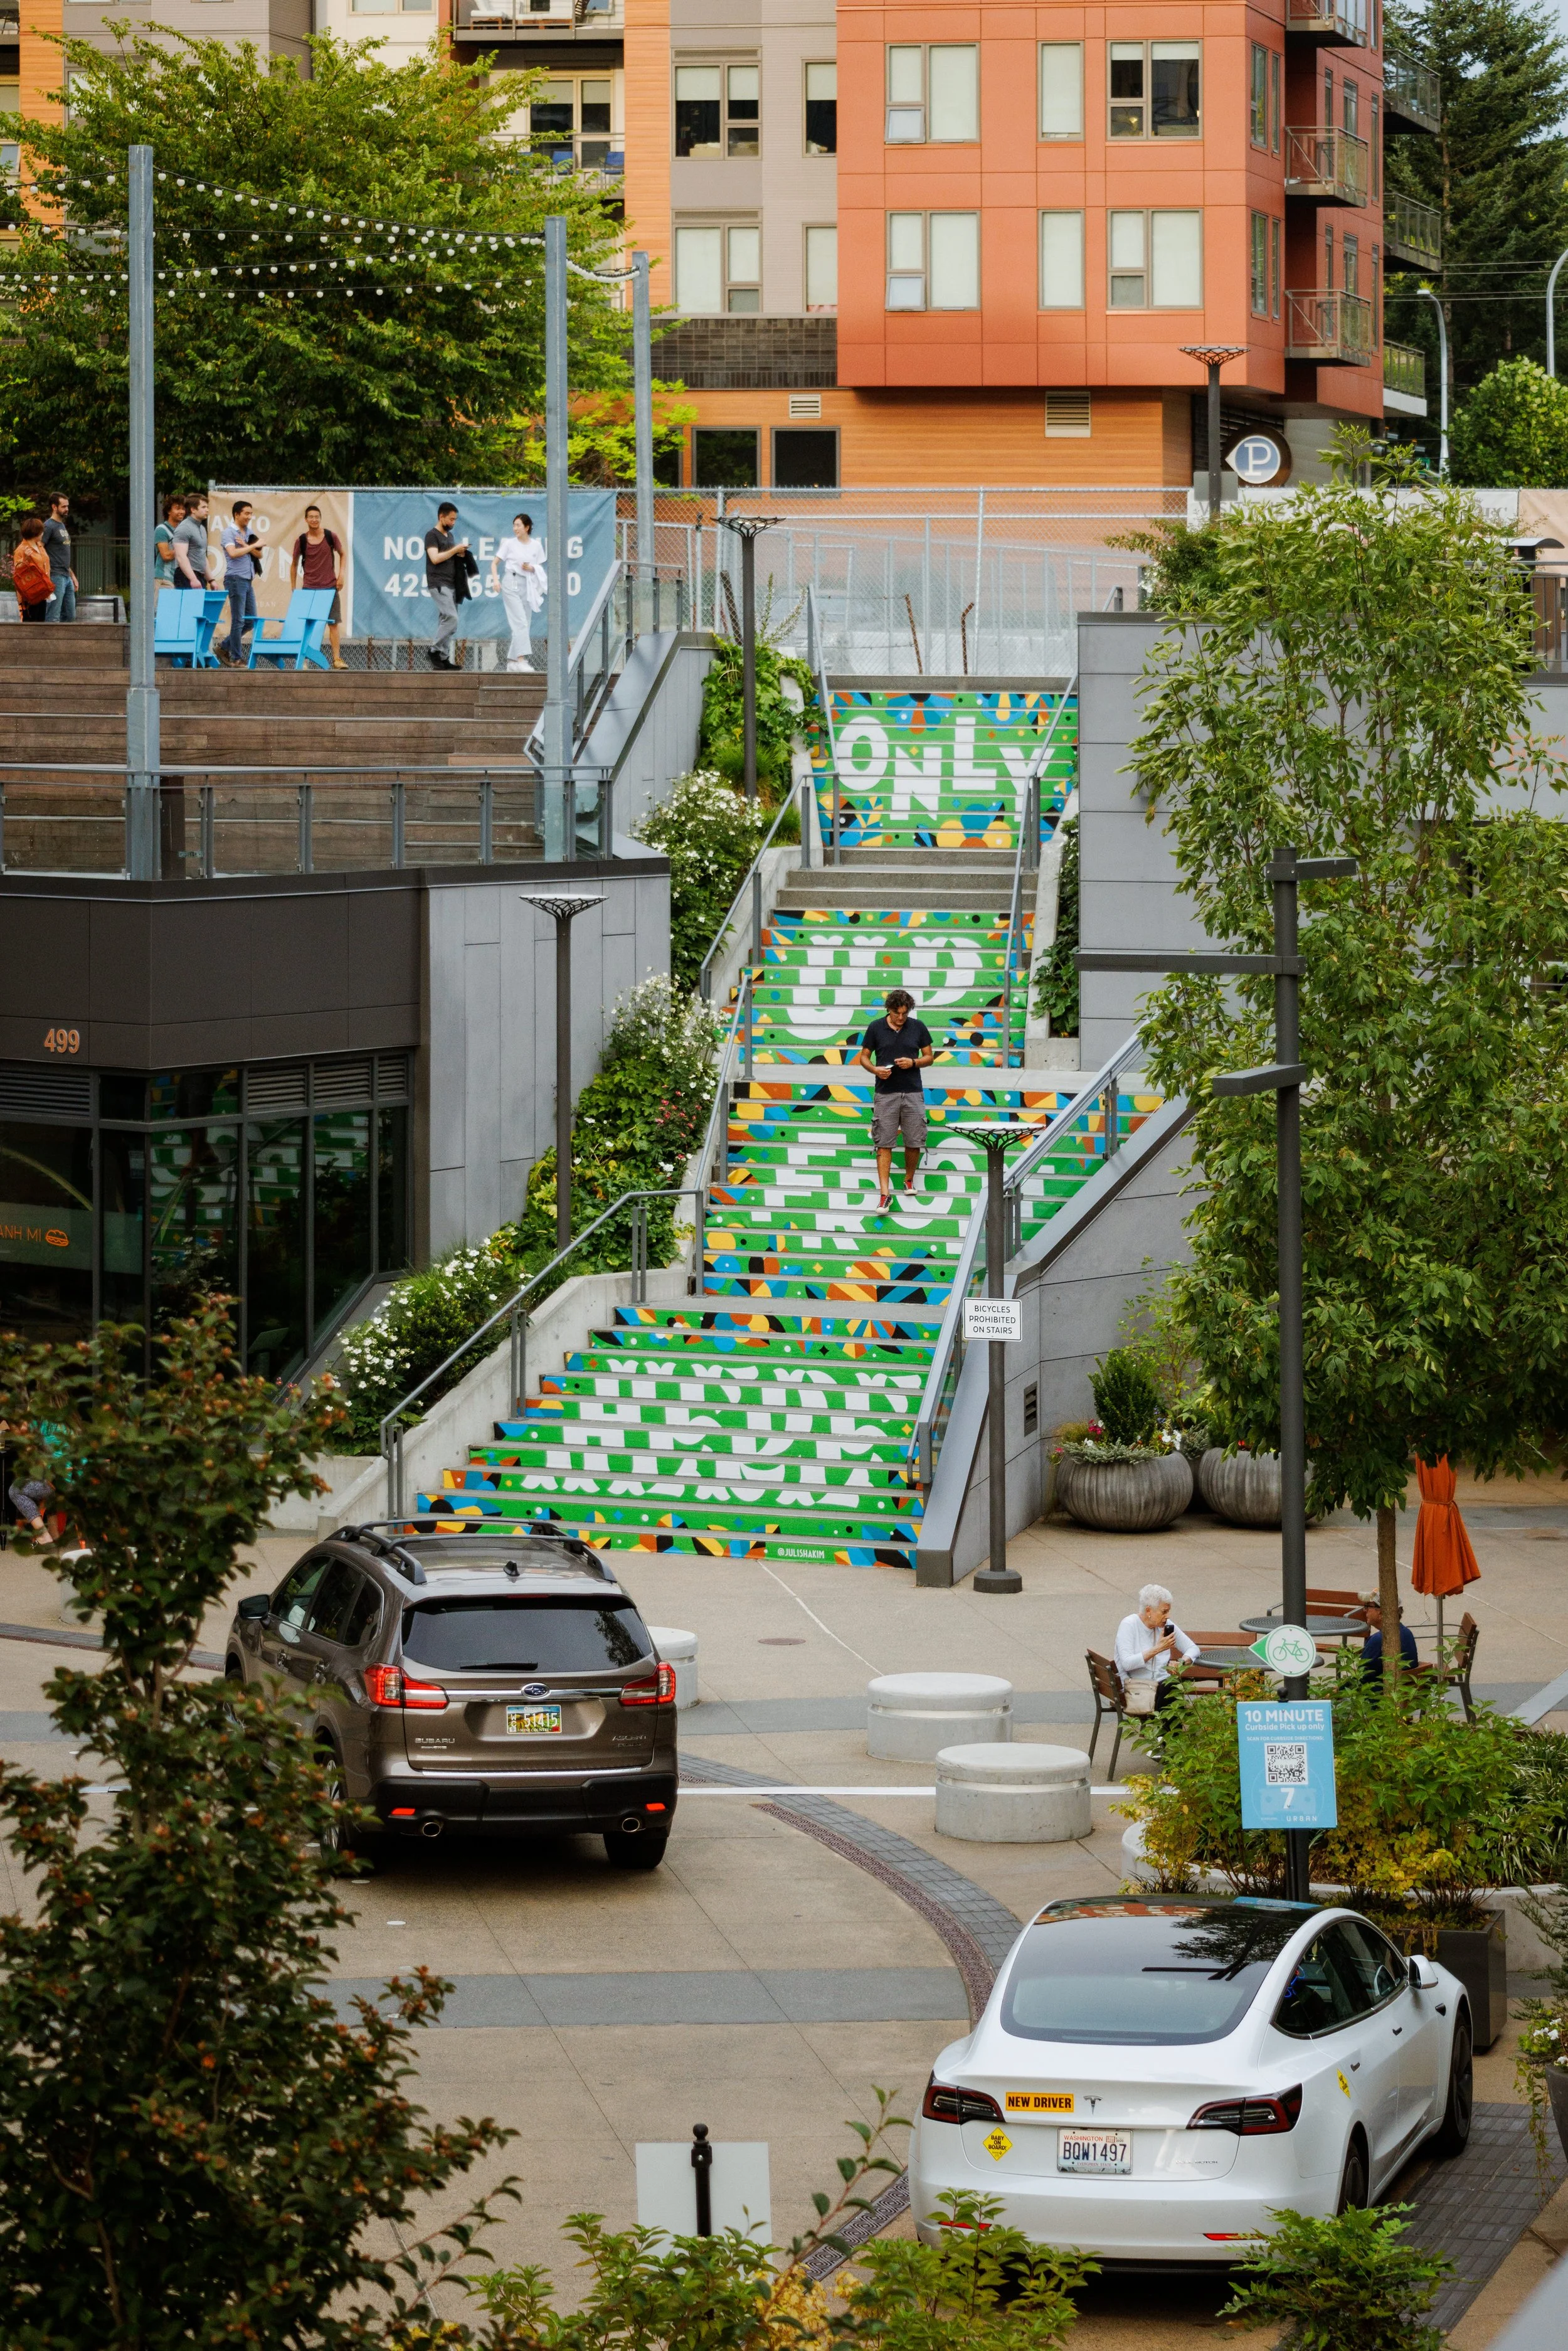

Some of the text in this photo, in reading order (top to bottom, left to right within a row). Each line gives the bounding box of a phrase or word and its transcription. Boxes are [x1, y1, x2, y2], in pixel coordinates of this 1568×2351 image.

[1244, 443, 1271, 476] P
[384, 536, 425, 560] NO
[468, 573, 499, 598] 65
[836, 716, 1056, 822] ONLY
[785, 935, 983, 1041] UP
[44, 1028, 80, 1054] 499
[27, 1226, 42, 1242] MI
[974, 1305, 1010, 1313] BICYCLES
[969, 1315, 1016, 1324] PROHIBITED
[986, 1326, 1012, 1334] STAIRS
[521, 1358, 923, 1508] HERE
[777, 1547, 825, 1559] @JULISHAKIM
[524, 1712, 558, 1727] 51415
[1244, 1709, 1324, 1722] 10 MINUTE
[1308, 1722, 1325, 1731] only
[1280, 1787, 1295, 1809] 7
[1008, 2096, 1072, 2109] NEW DRIVER
[1063, 2141, 1128, 2162] BQW1497
